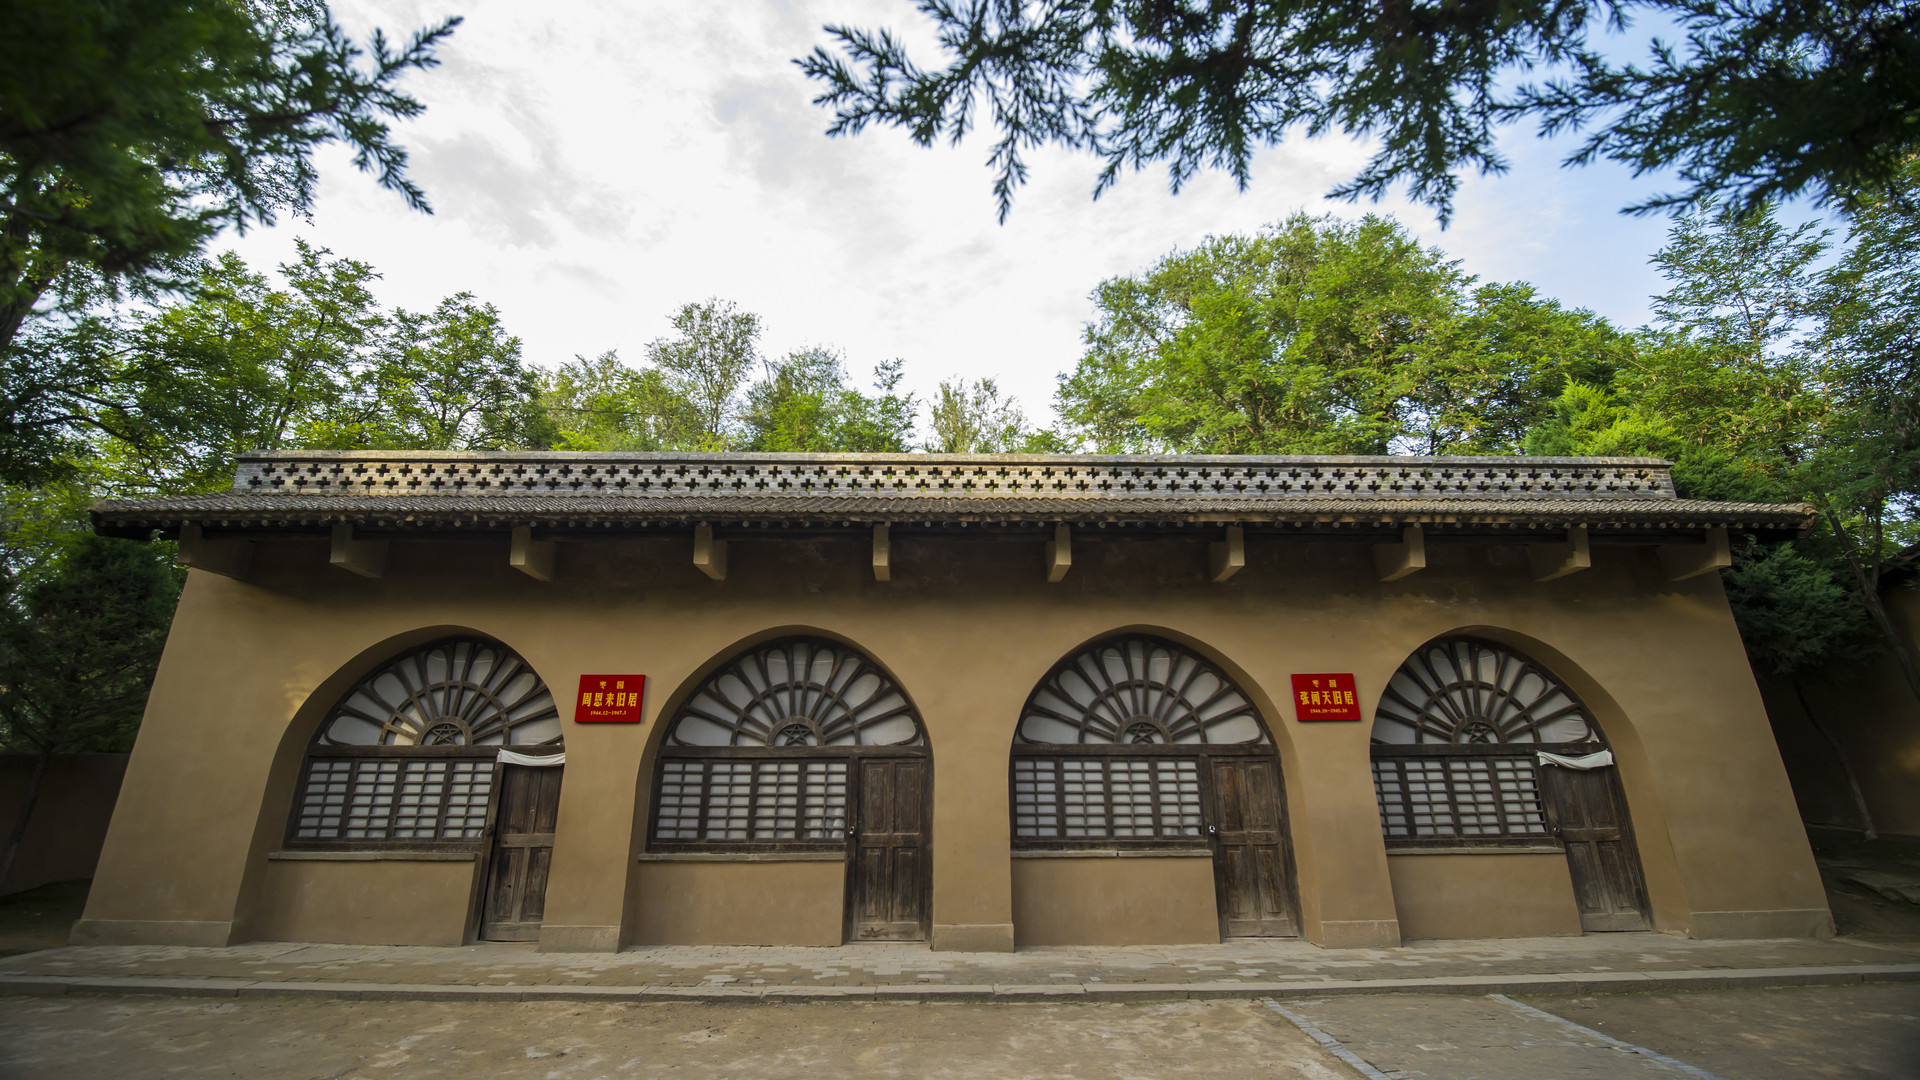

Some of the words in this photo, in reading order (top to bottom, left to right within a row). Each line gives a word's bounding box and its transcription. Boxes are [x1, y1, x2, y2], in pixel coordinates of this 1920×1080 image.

[582, 692, 638, 707] 周恩来旧居
[1299, 690, 1354, 706] 张闻天旧居
